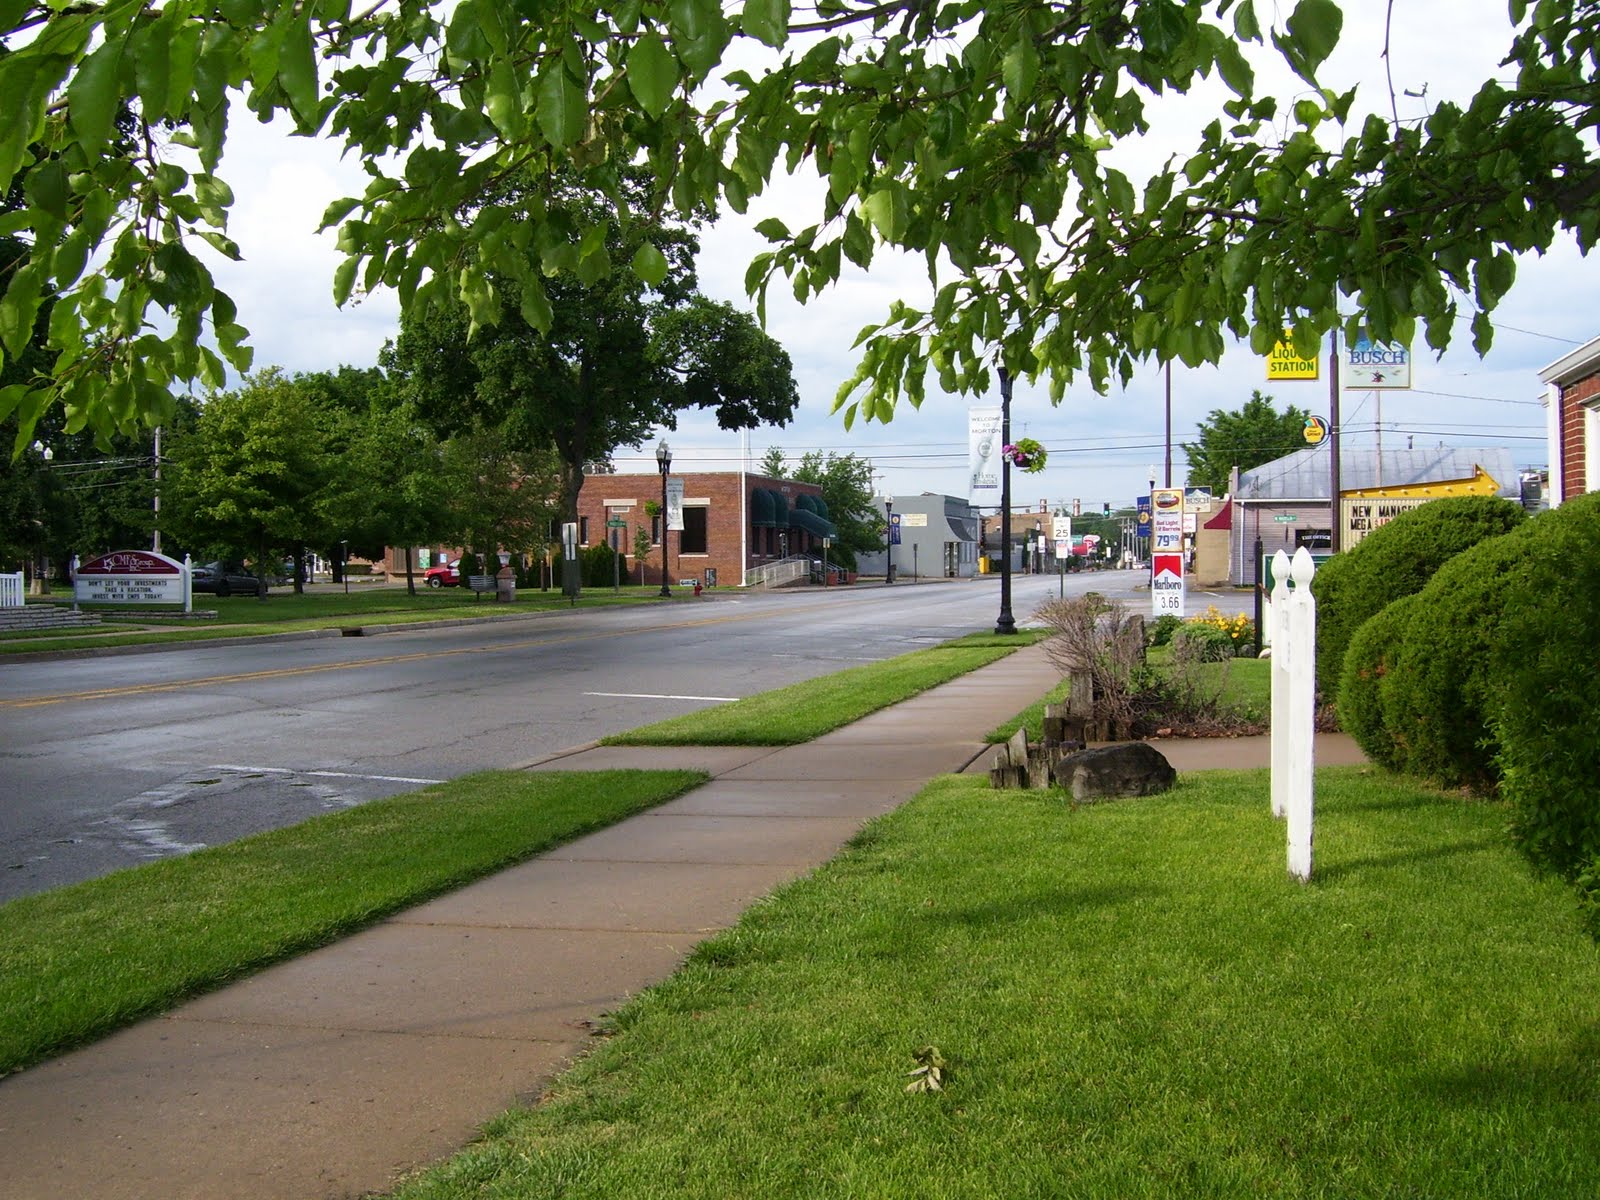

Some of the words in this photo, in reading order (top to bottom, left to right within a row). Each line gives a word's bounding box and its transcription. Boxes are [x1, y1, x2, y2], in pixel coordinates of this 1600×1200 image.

[1272, 349, 1298, 360] LIQU
[1349, 351, 1406, 364] BUSCH
[1271, 362, 1314, 372] STATION
[1352, 506, 1372, 517] NEW
[1351, 519, 1372, 530] MEGA
[1055, 529, 1068, 537] 25
[1154, 577, 1182, 590] Marlboro
[1162, 597, 1180, 608] 3.66
